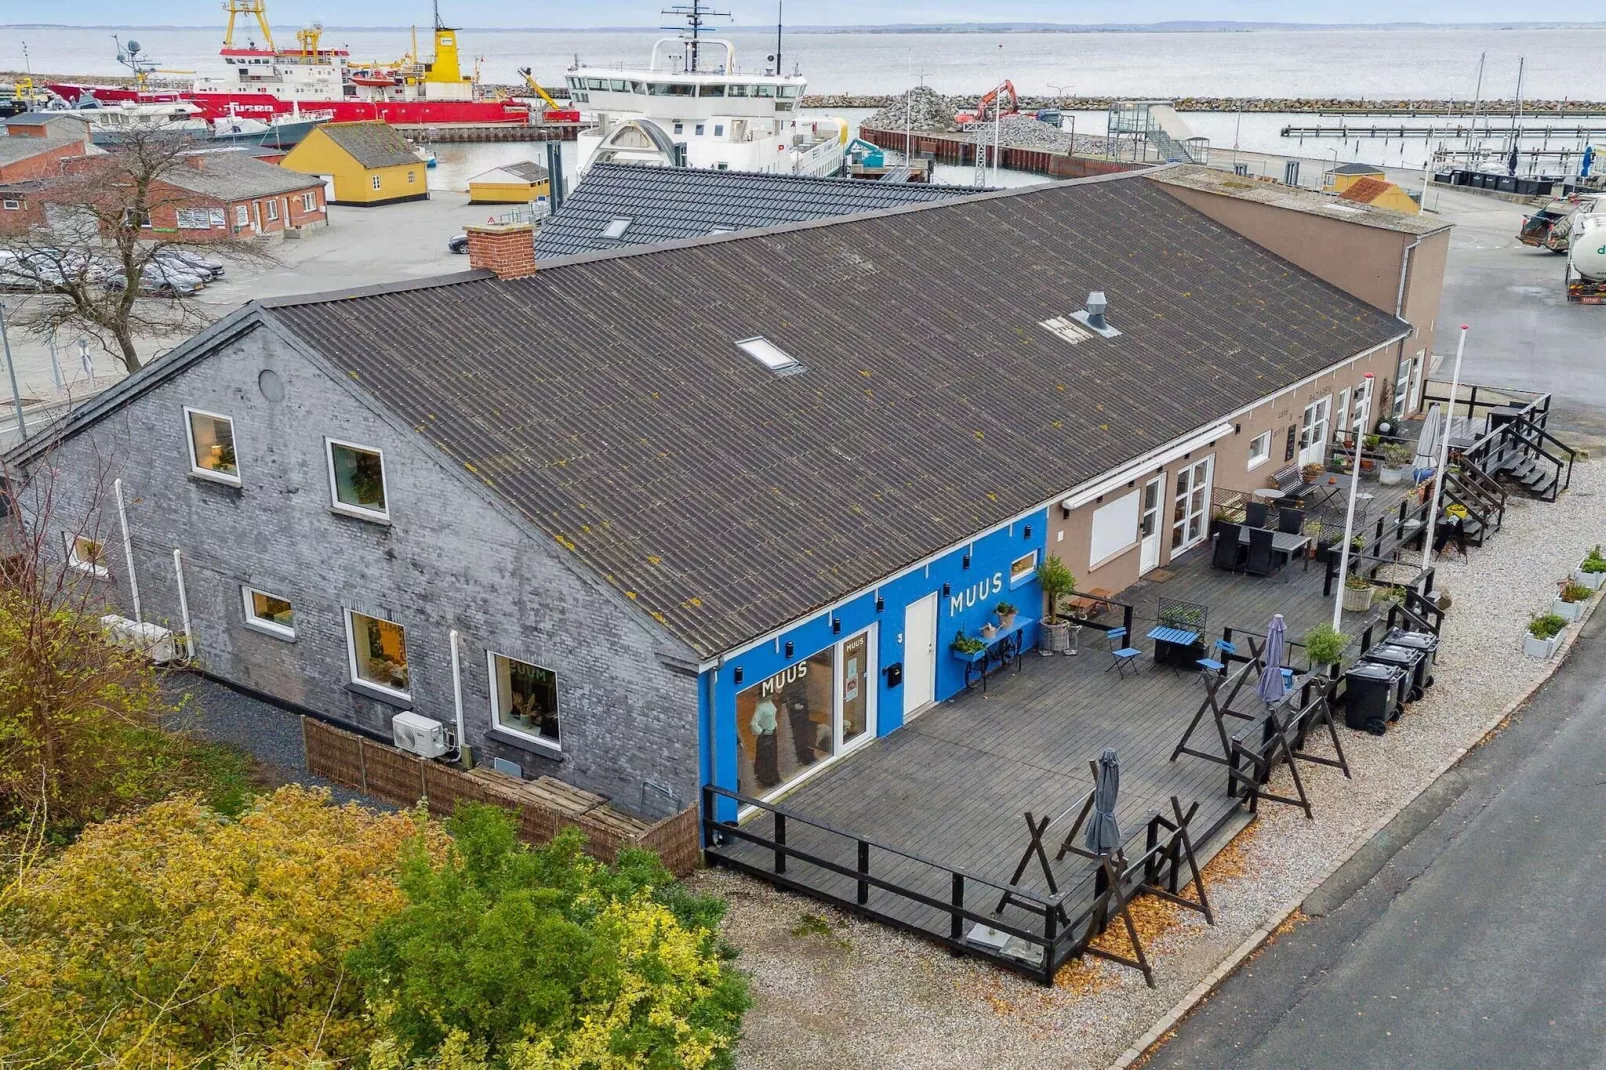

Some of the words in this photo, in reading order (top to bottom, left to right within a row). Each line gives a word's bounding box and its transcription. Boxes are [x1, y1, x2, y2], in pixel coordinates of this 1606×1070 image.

[950, 572, 1002, 617] MUUS
[846, 637, 864, 652] MUUS
[897, 633, 903, 643] 5
[762, 660, 807, 698] MUUS
